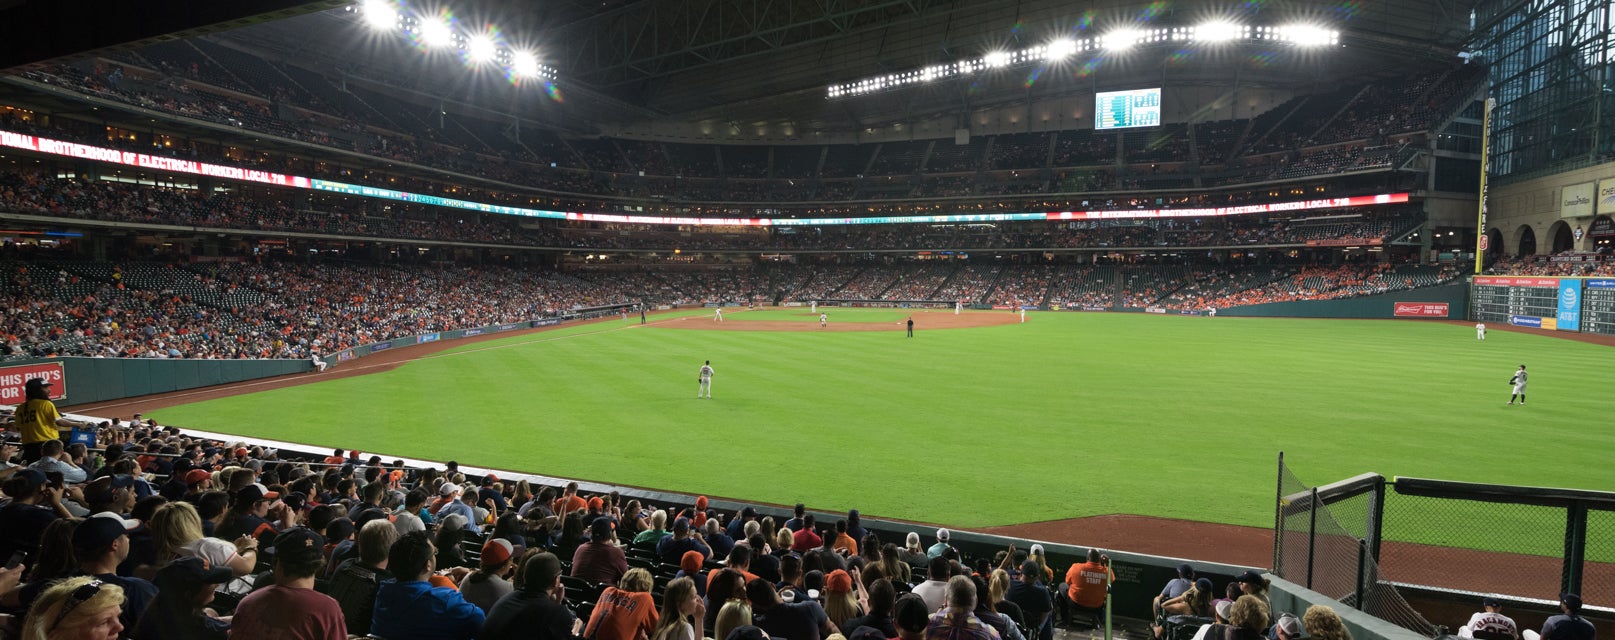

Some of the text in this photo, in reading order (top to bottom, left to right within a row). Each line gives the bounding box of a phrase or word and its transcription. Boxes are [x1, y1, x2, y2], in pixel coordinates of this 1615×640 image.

[122, 152, 136, 165] OF
[139, 154, 199, 174] ELECTRICAL
[201, 163, 243, 180] WORKERS
[245, 170, 270, 183] LOCAL
[1086, 210, 1101, 218] THE
[1217, 207, 1227, 215] OF
[1227, 204, 1267, 214] ELECTRICAL
[1307, 199, 1331, 209] LOCAL
[1560, 312, 1577, 321] AT&T
[0, 374, 22, 386] HIS
[0, 387, 19, 399] OR
[1080, 570, 1107, 579] PLATINUM
